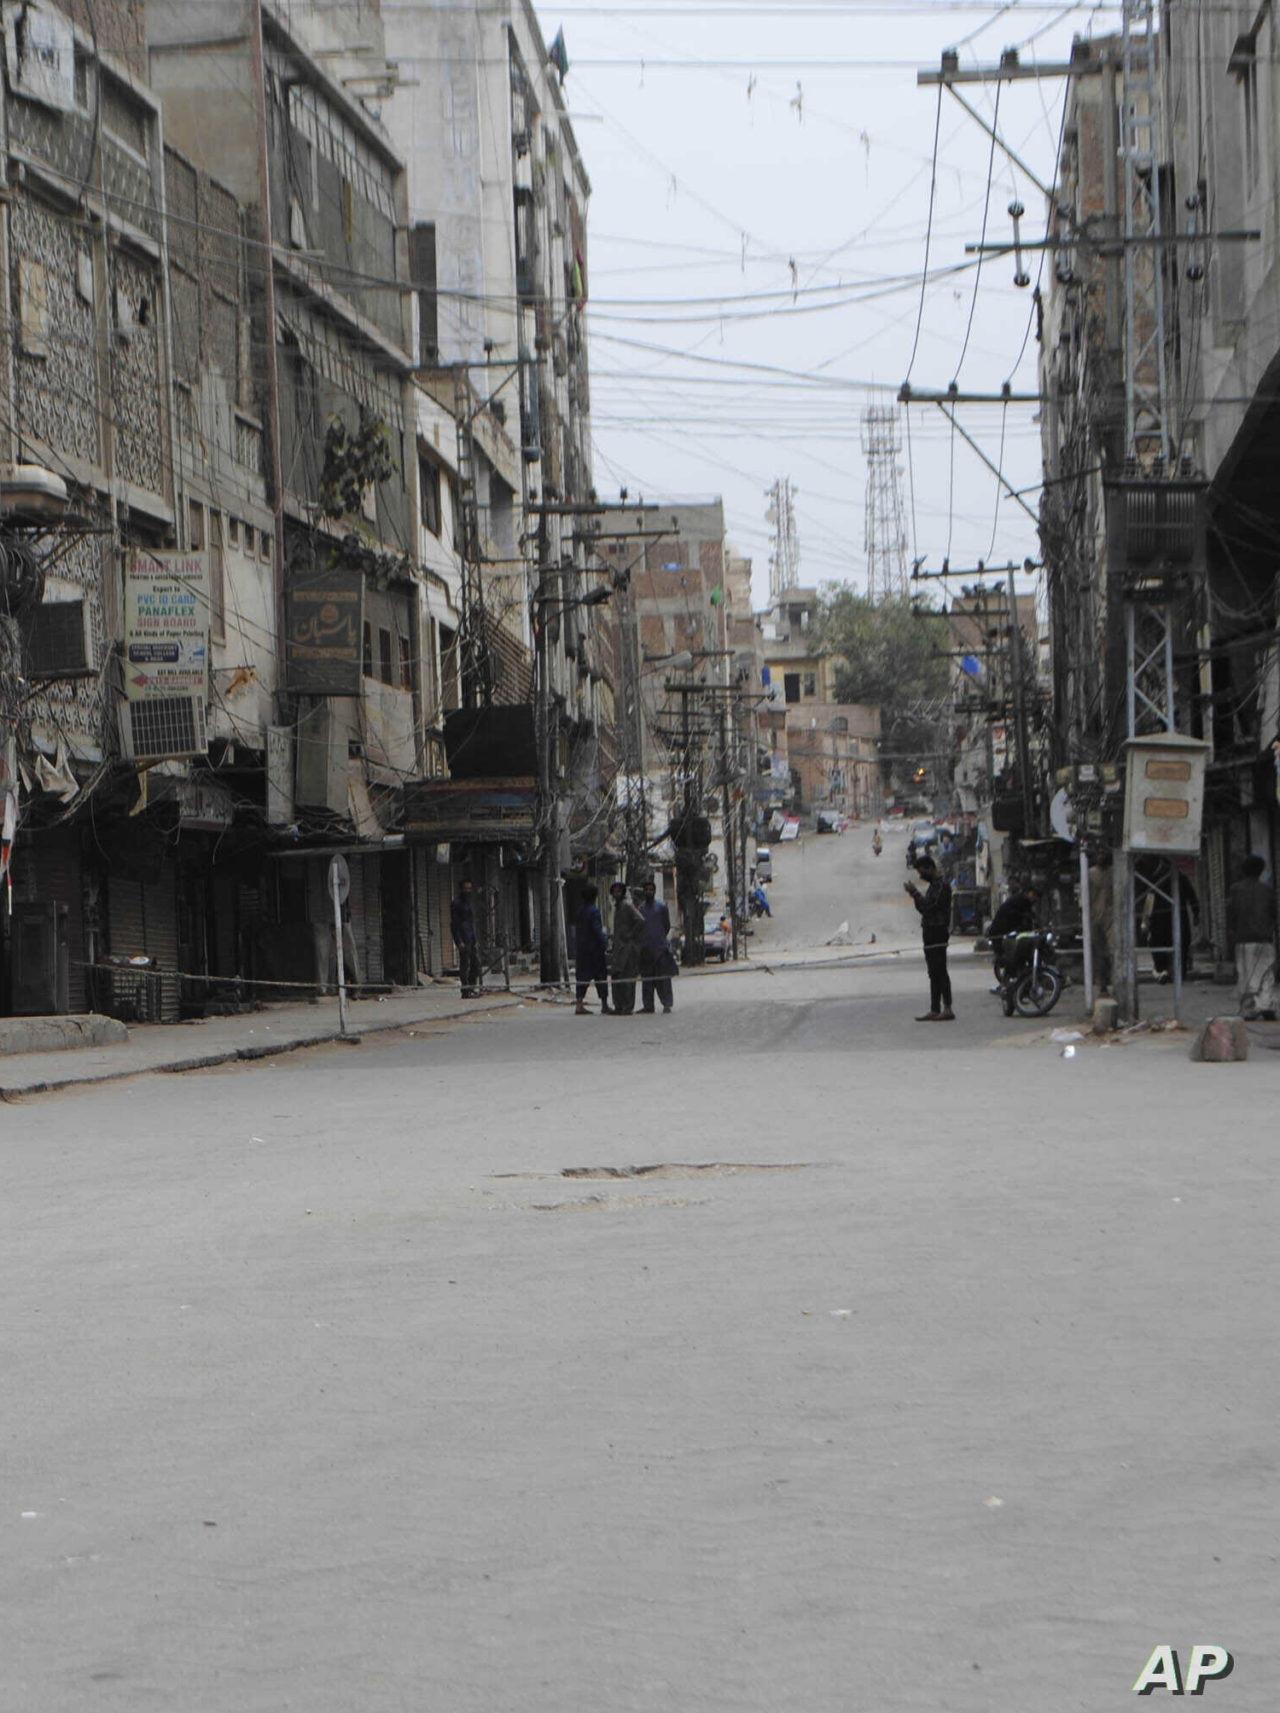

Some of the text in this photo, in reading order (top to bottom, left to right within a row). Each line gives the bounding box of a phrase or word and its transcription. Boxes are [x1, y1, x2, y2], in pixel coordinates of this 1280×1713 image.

[174, 558, 202, 573] LINK
[137, 594, 154, 604] PVC
[171, 594, 196, 604] CARD
[138, 606, 195, 616] PANAFLEX
[137, 617, 196, 628] SIGN BOARD
